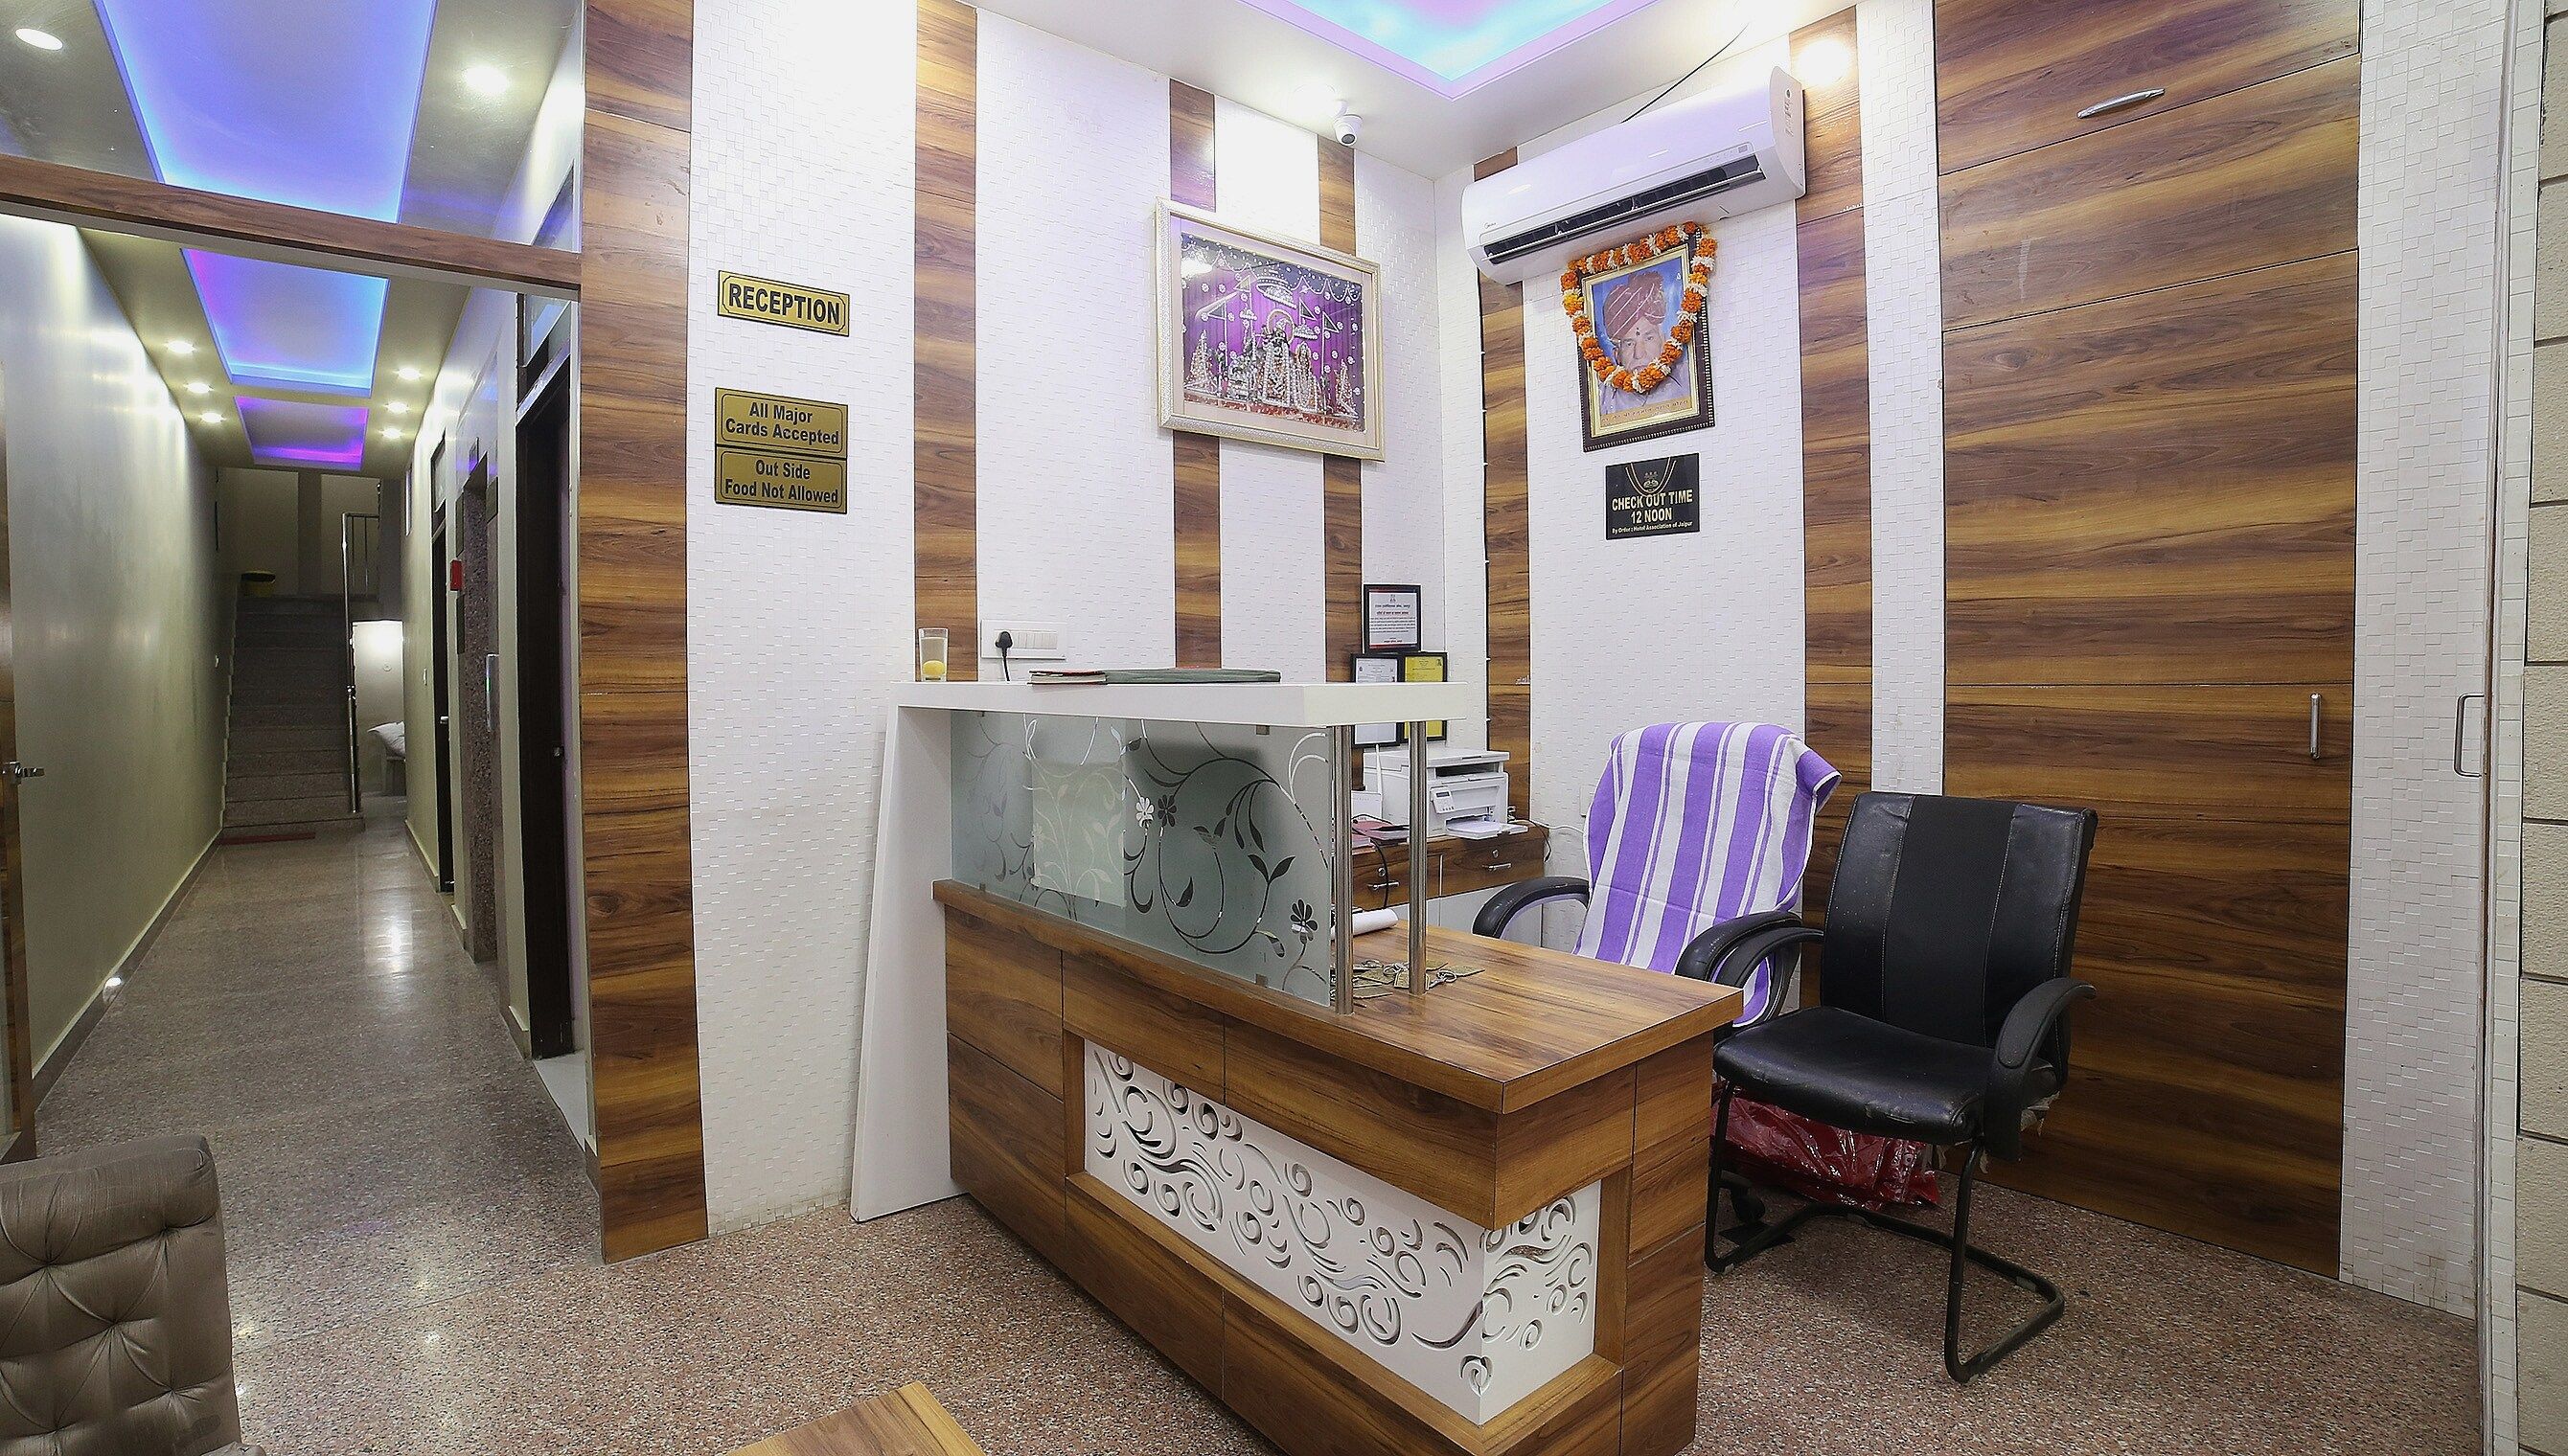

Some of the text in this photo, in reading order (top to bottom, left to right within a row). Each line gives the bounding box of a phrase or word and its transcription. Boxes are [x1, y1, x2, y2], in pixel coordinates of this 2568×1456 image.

[729, 283, 839, 325] RECEPTION
[749, 401, 813, 425] All Major
[725, 418, 839, 445] Cards Accepted
[755, 459, 811, 480] Out Side
[725, 478, 838, 504] Food Not Allowed
[1612, 489, 1693, 512] CHECK OUT TIME
[1631, 507, 1673, 524] 12 NOON
